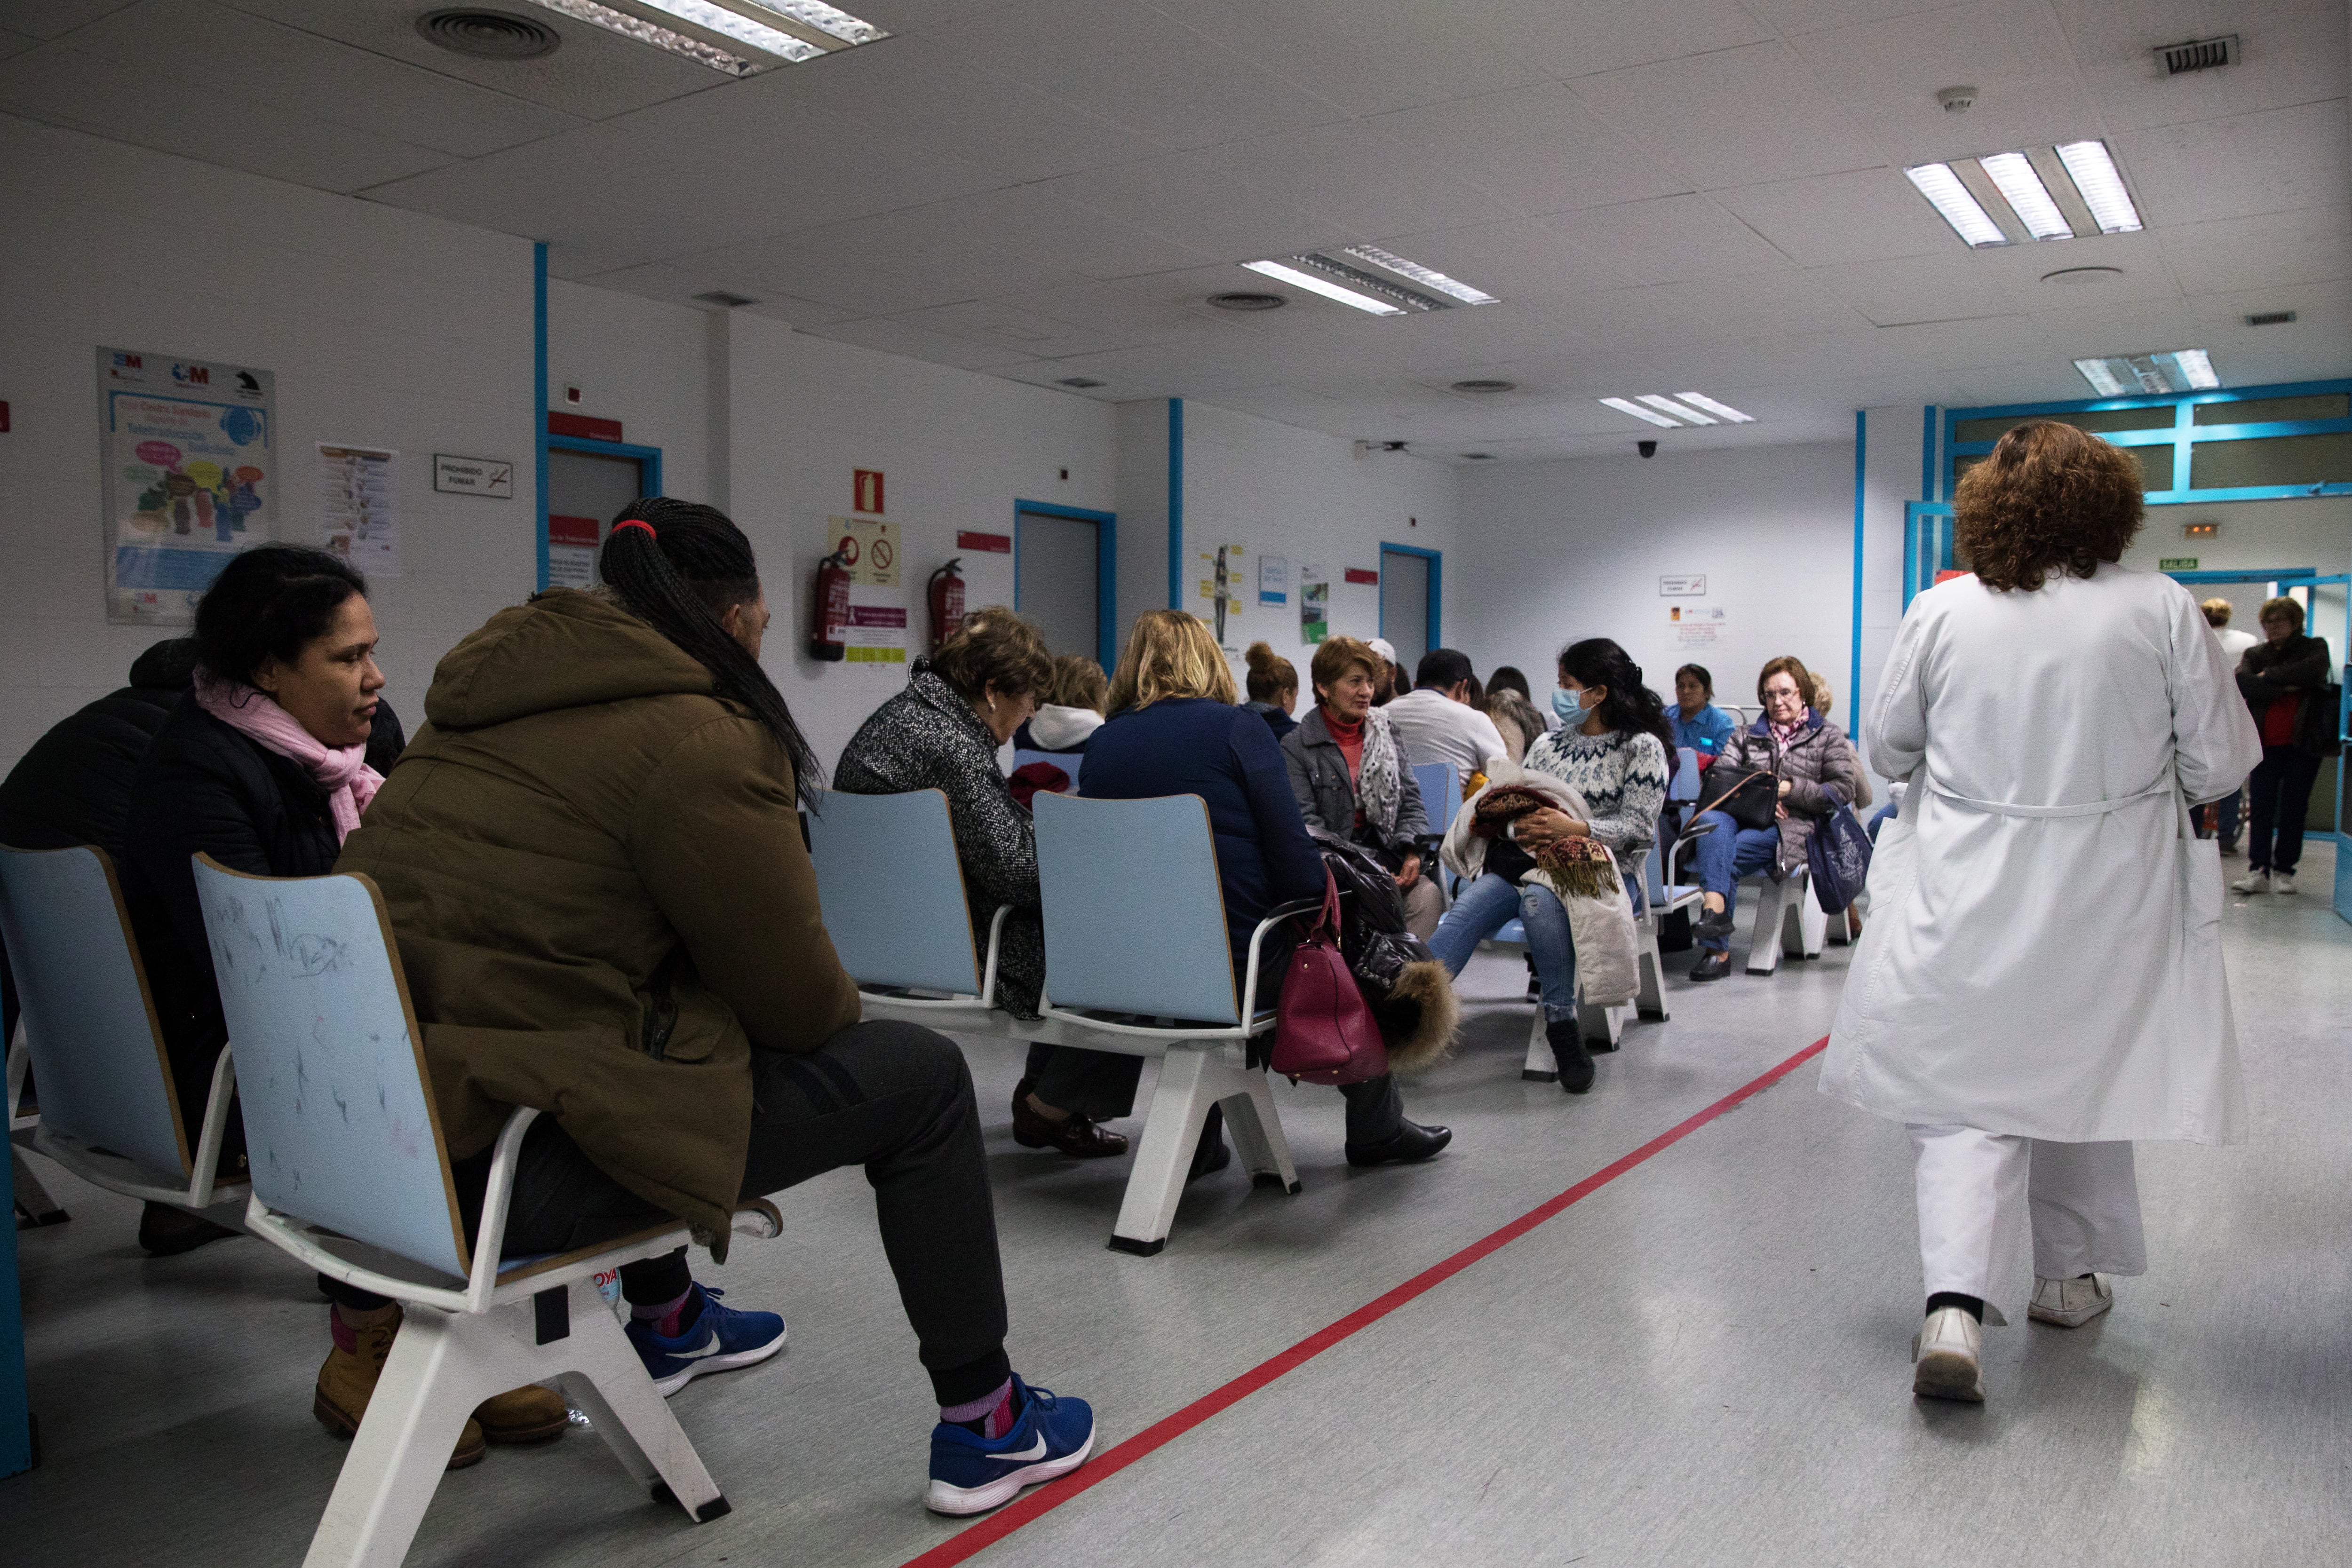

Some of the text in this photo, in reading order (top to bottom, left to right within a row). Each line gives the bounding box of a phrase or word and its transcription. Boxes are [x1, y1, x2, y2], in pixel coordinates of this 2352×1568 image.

[140, 402, 169, 413] Centro
[172, 405, 211, 418] Sanitario
[441, 464, 483, 476] PROHIBIDO
[448, 476, 476, 485] FUMAR
[593, 1267, 617, 1287] OYA
